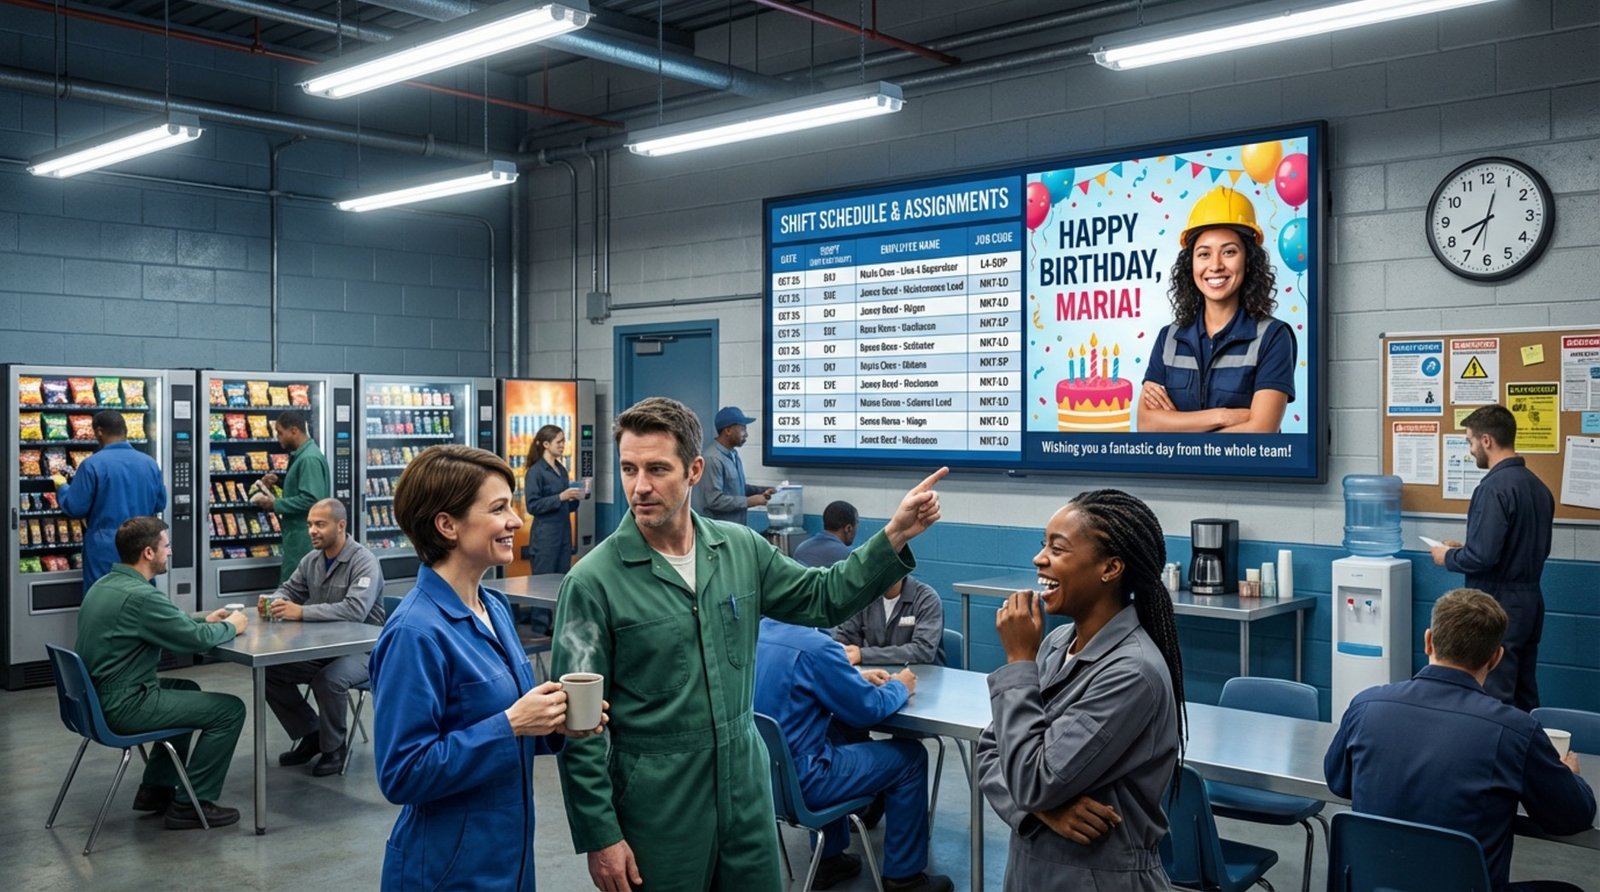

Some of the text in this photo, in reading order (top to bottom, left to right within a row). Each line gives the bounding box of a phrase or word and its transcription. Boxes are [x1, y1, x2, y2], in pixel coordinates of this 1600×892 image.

[1480, 173, 1495, 184] 12
[1506, 176, 1511, 187] 1
[1462, 181, 1472, 192] 11
[1519, 189, 1528, 201] 2
[1448, 196, 1461, 208] 10
[780, 187, 1008, 234] SHIFT SCHEDULE & ASSIGNMENTS
[1526, 210, 1534, 221] 3
[1442, 217, 1450, 228] 9
[1059, 213, 1138, 250] HAPPY
[1518, 231, 1526, 242] 4
[1448, 237, 1456, 247] 8
[1463, 250, 1471, 262] 7
[1504, 247, 1512, 259] 5
[1483, 255, 1491, 266] 6
[1040, 248, 1161, 286] BIRTHDAY,
[1056, 288, 1141, 321] MARIA!
[1042, 441, 1292, 457] Wishing you a fantastic day from the whole team!
